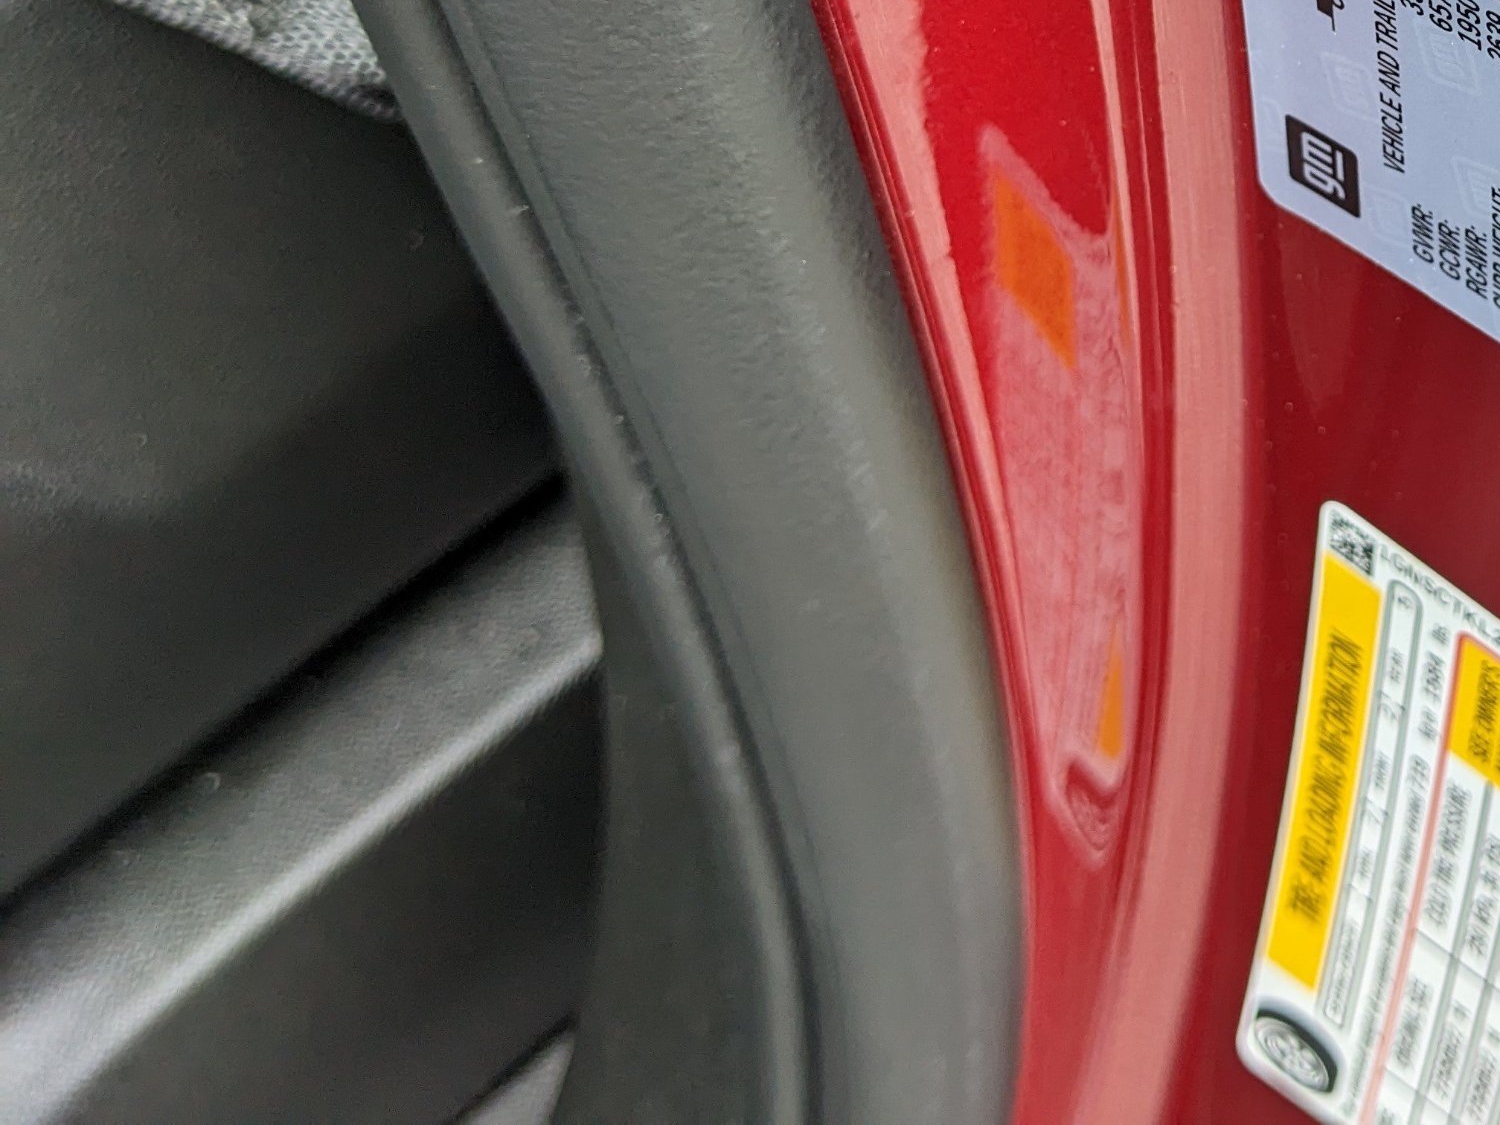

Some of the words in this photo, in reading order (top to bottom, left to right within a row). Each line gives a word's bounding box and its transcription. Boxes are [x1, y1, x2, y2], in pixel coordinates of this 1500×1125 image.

[1376, 49, 1401, 88] AND
[1378, 91, 1405, 173] VEHICLE
[1301, 132, 1346, 199] gm
[1411, 203, 1434, 264] GVWR:
[1438, 219, 1461, 281] GCWR:
[1464, 225, 1488, 300] RGAWR:
